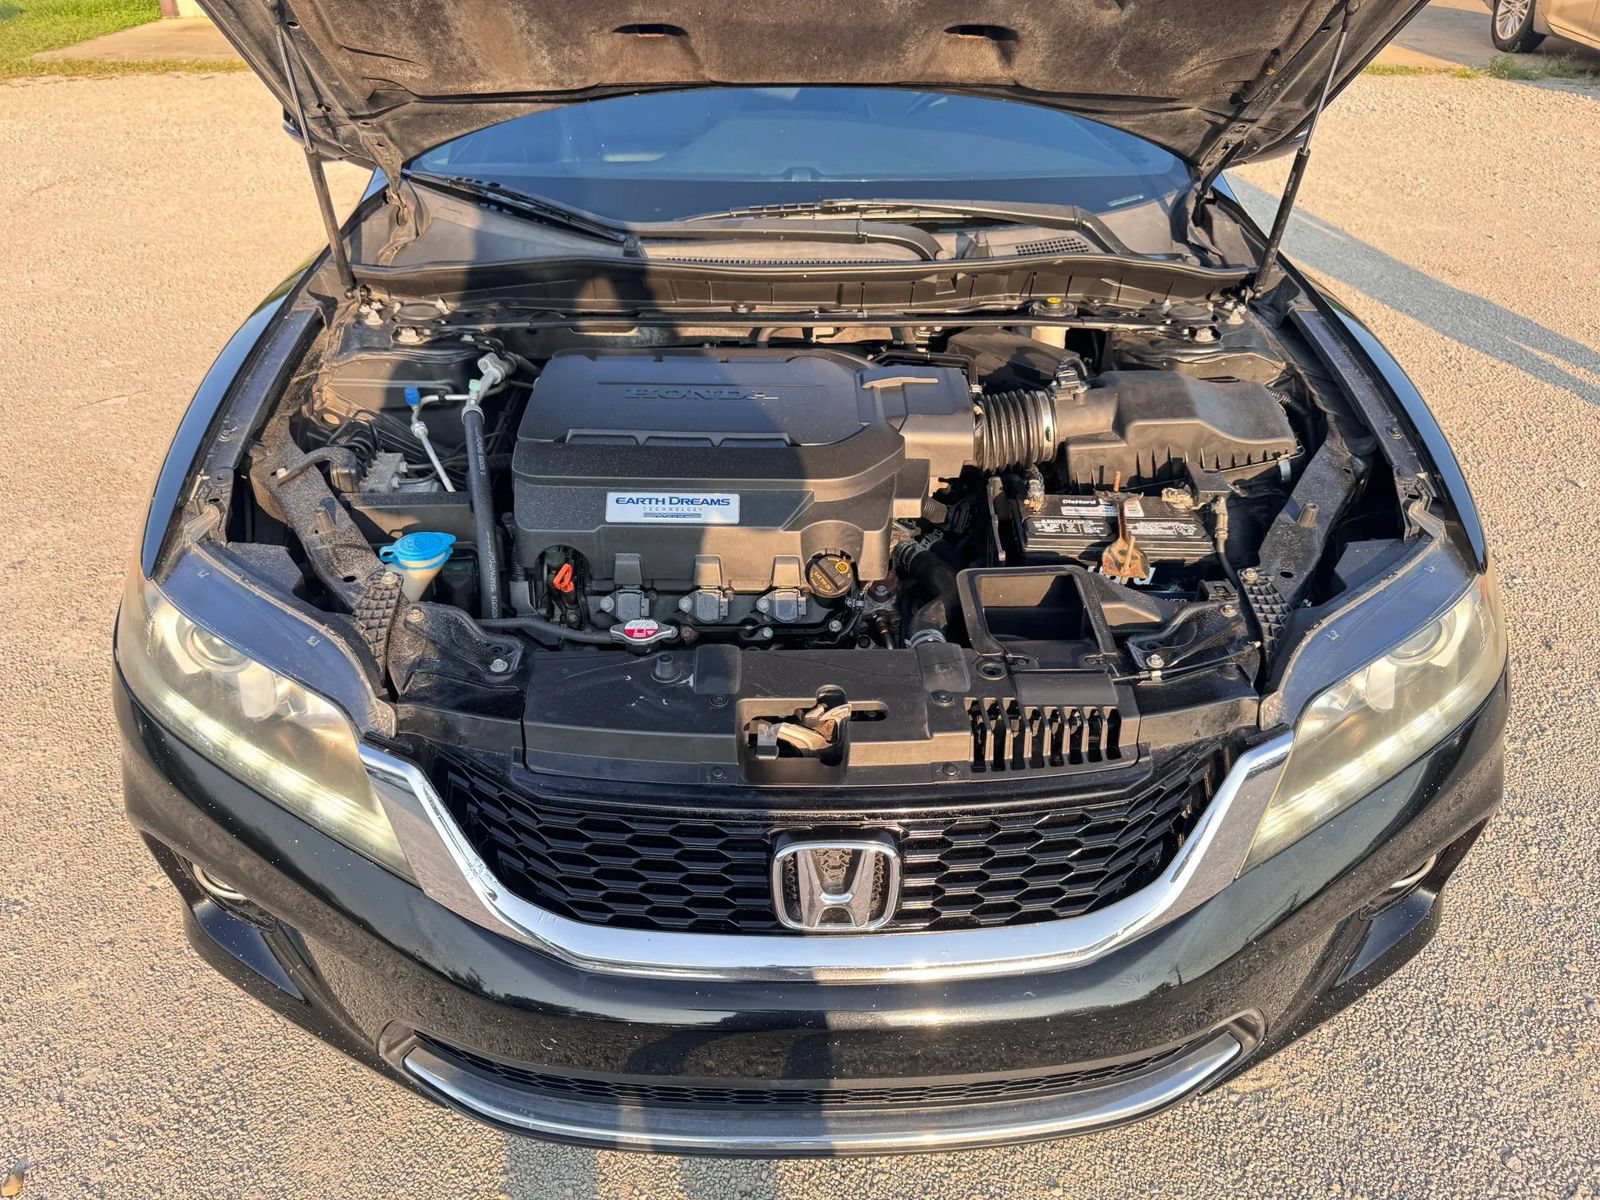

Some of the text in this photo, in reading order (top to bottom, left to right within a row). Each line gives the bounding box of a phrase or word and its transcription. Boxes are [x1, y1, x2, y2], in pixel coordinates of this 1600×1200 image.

[624, 388, 779, 401] HONDA
[615, 496, 731, 506] EARTH DREAMS
